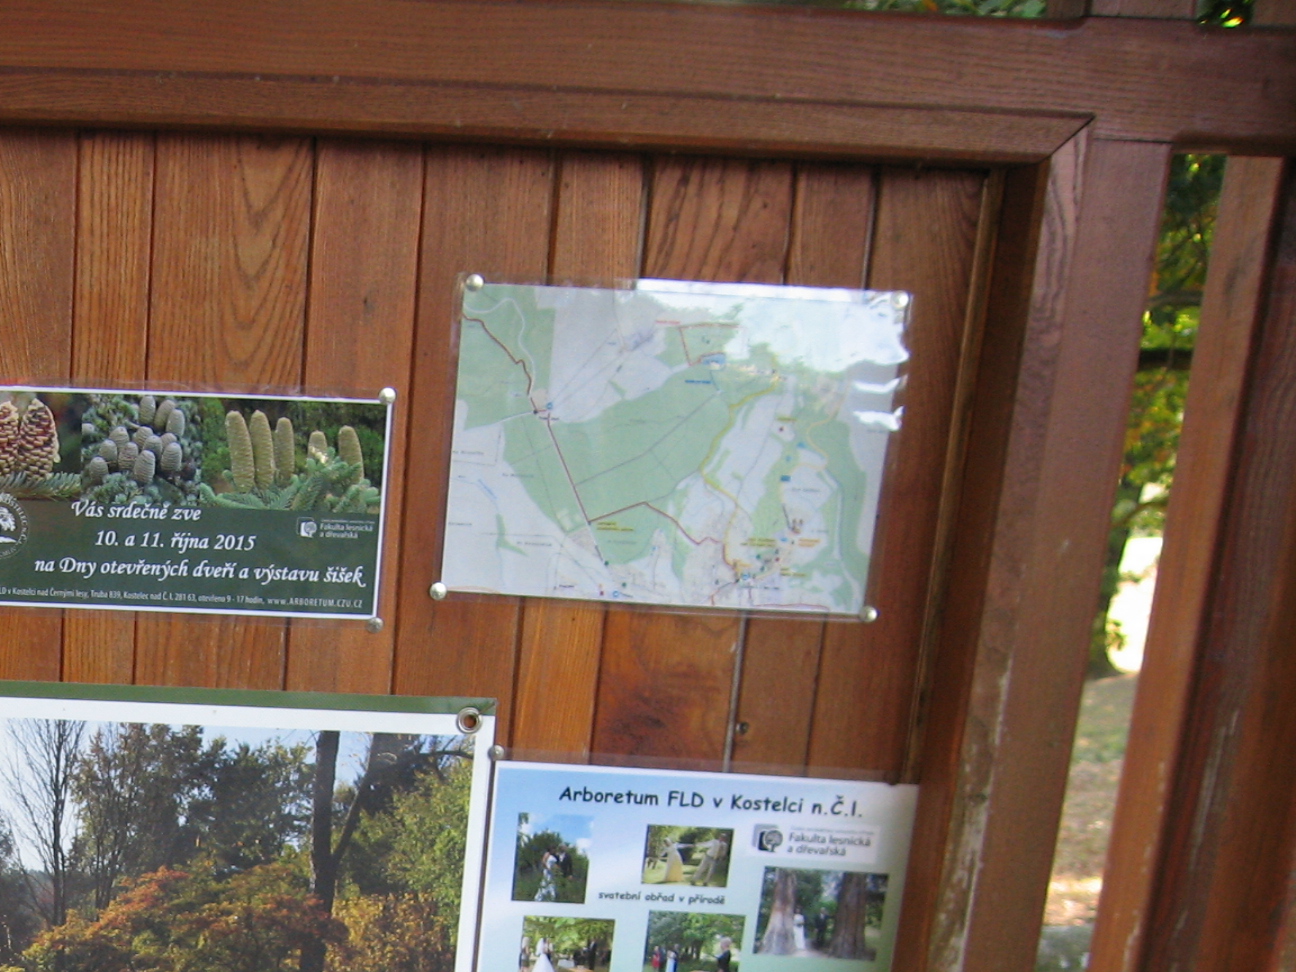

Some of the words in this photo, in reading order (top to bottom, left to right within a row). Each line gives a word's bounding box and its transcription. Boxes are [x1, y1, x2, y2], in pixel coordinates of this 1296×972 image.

[71, 500, 104, 518] Vás
[108, 501, 168, 520] srdečně
[171, 508, 201, 520] zve
[95, 530, 118, 546] 10.
[125, 534, 136, 547] a
[140, 532, 164, 548] 11.
[170, 532, 208, 554] října
[214, 534, 256, 550] 2015
[34, 560, 54, 572] na
[60, 557, 96, 578] Dny
[100, 559, 189, 581] otevřených
[193, 560, 234, 579] dveří
[239, 568, 249, 579] a
[254, 564, 319, 585] výstavu
[324, 566, 366, 588] šišek
[12, 587, 36, 596] Kostelci
[38, 588, 48, 596] nad
[50, 586, 74, 598] Černými
[90, 589, 108, 598] Truba
[124, 590, 148, 600] Kostelec
[150, 591, 160, 600] nad
[175, 592, 187, 600] 281
[559, 786, 659, 807] Arboretum
[668, 790, 703, 808] FLD
[713, 798, 724, 809] v
[731, 794, 802, 814] Kostelci
[812, 794, 863, 818] n.Č.l.
[789, 832, 826, 844] Fakulta
[828, 833, 871, 847] lesnická
[796, 846, 846, 856] dřevařská
[598, 890, 640, 902] svatební
[644, 892, 674, 903] obřad
[688, 891, 725, 906] přírodě
